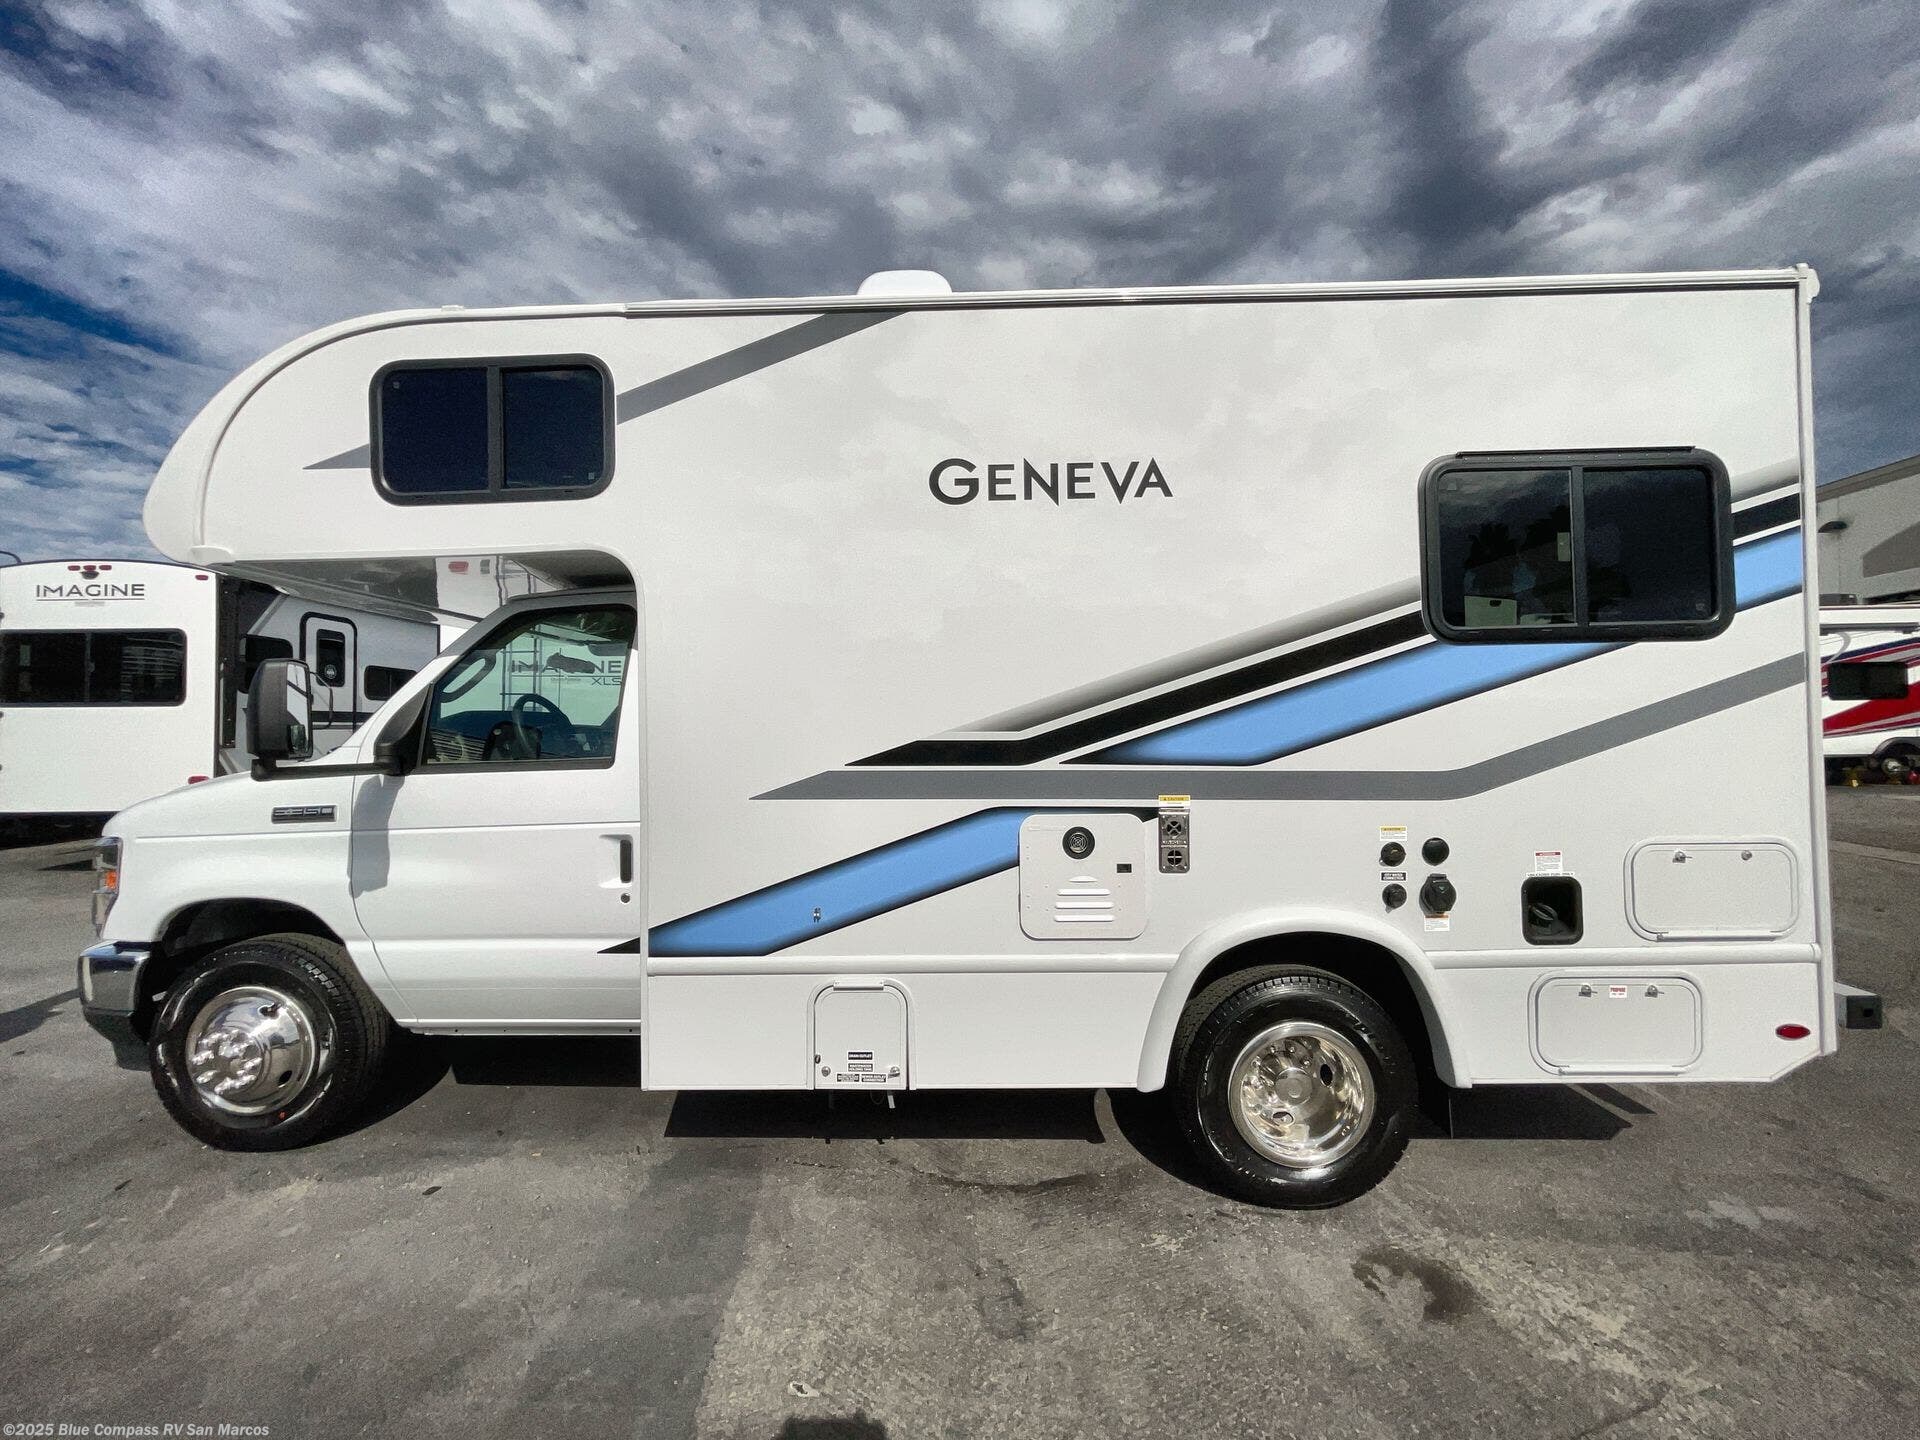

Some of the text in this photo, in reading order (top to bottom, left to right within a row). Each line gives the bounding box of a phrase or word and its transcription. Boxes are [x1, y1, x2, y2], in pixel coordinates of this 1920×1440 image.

[929, 457, 1173, 506] GENEVA
[36, 584, 145, 597] IMAGINE
[591, 677, 622, 685] XLS
